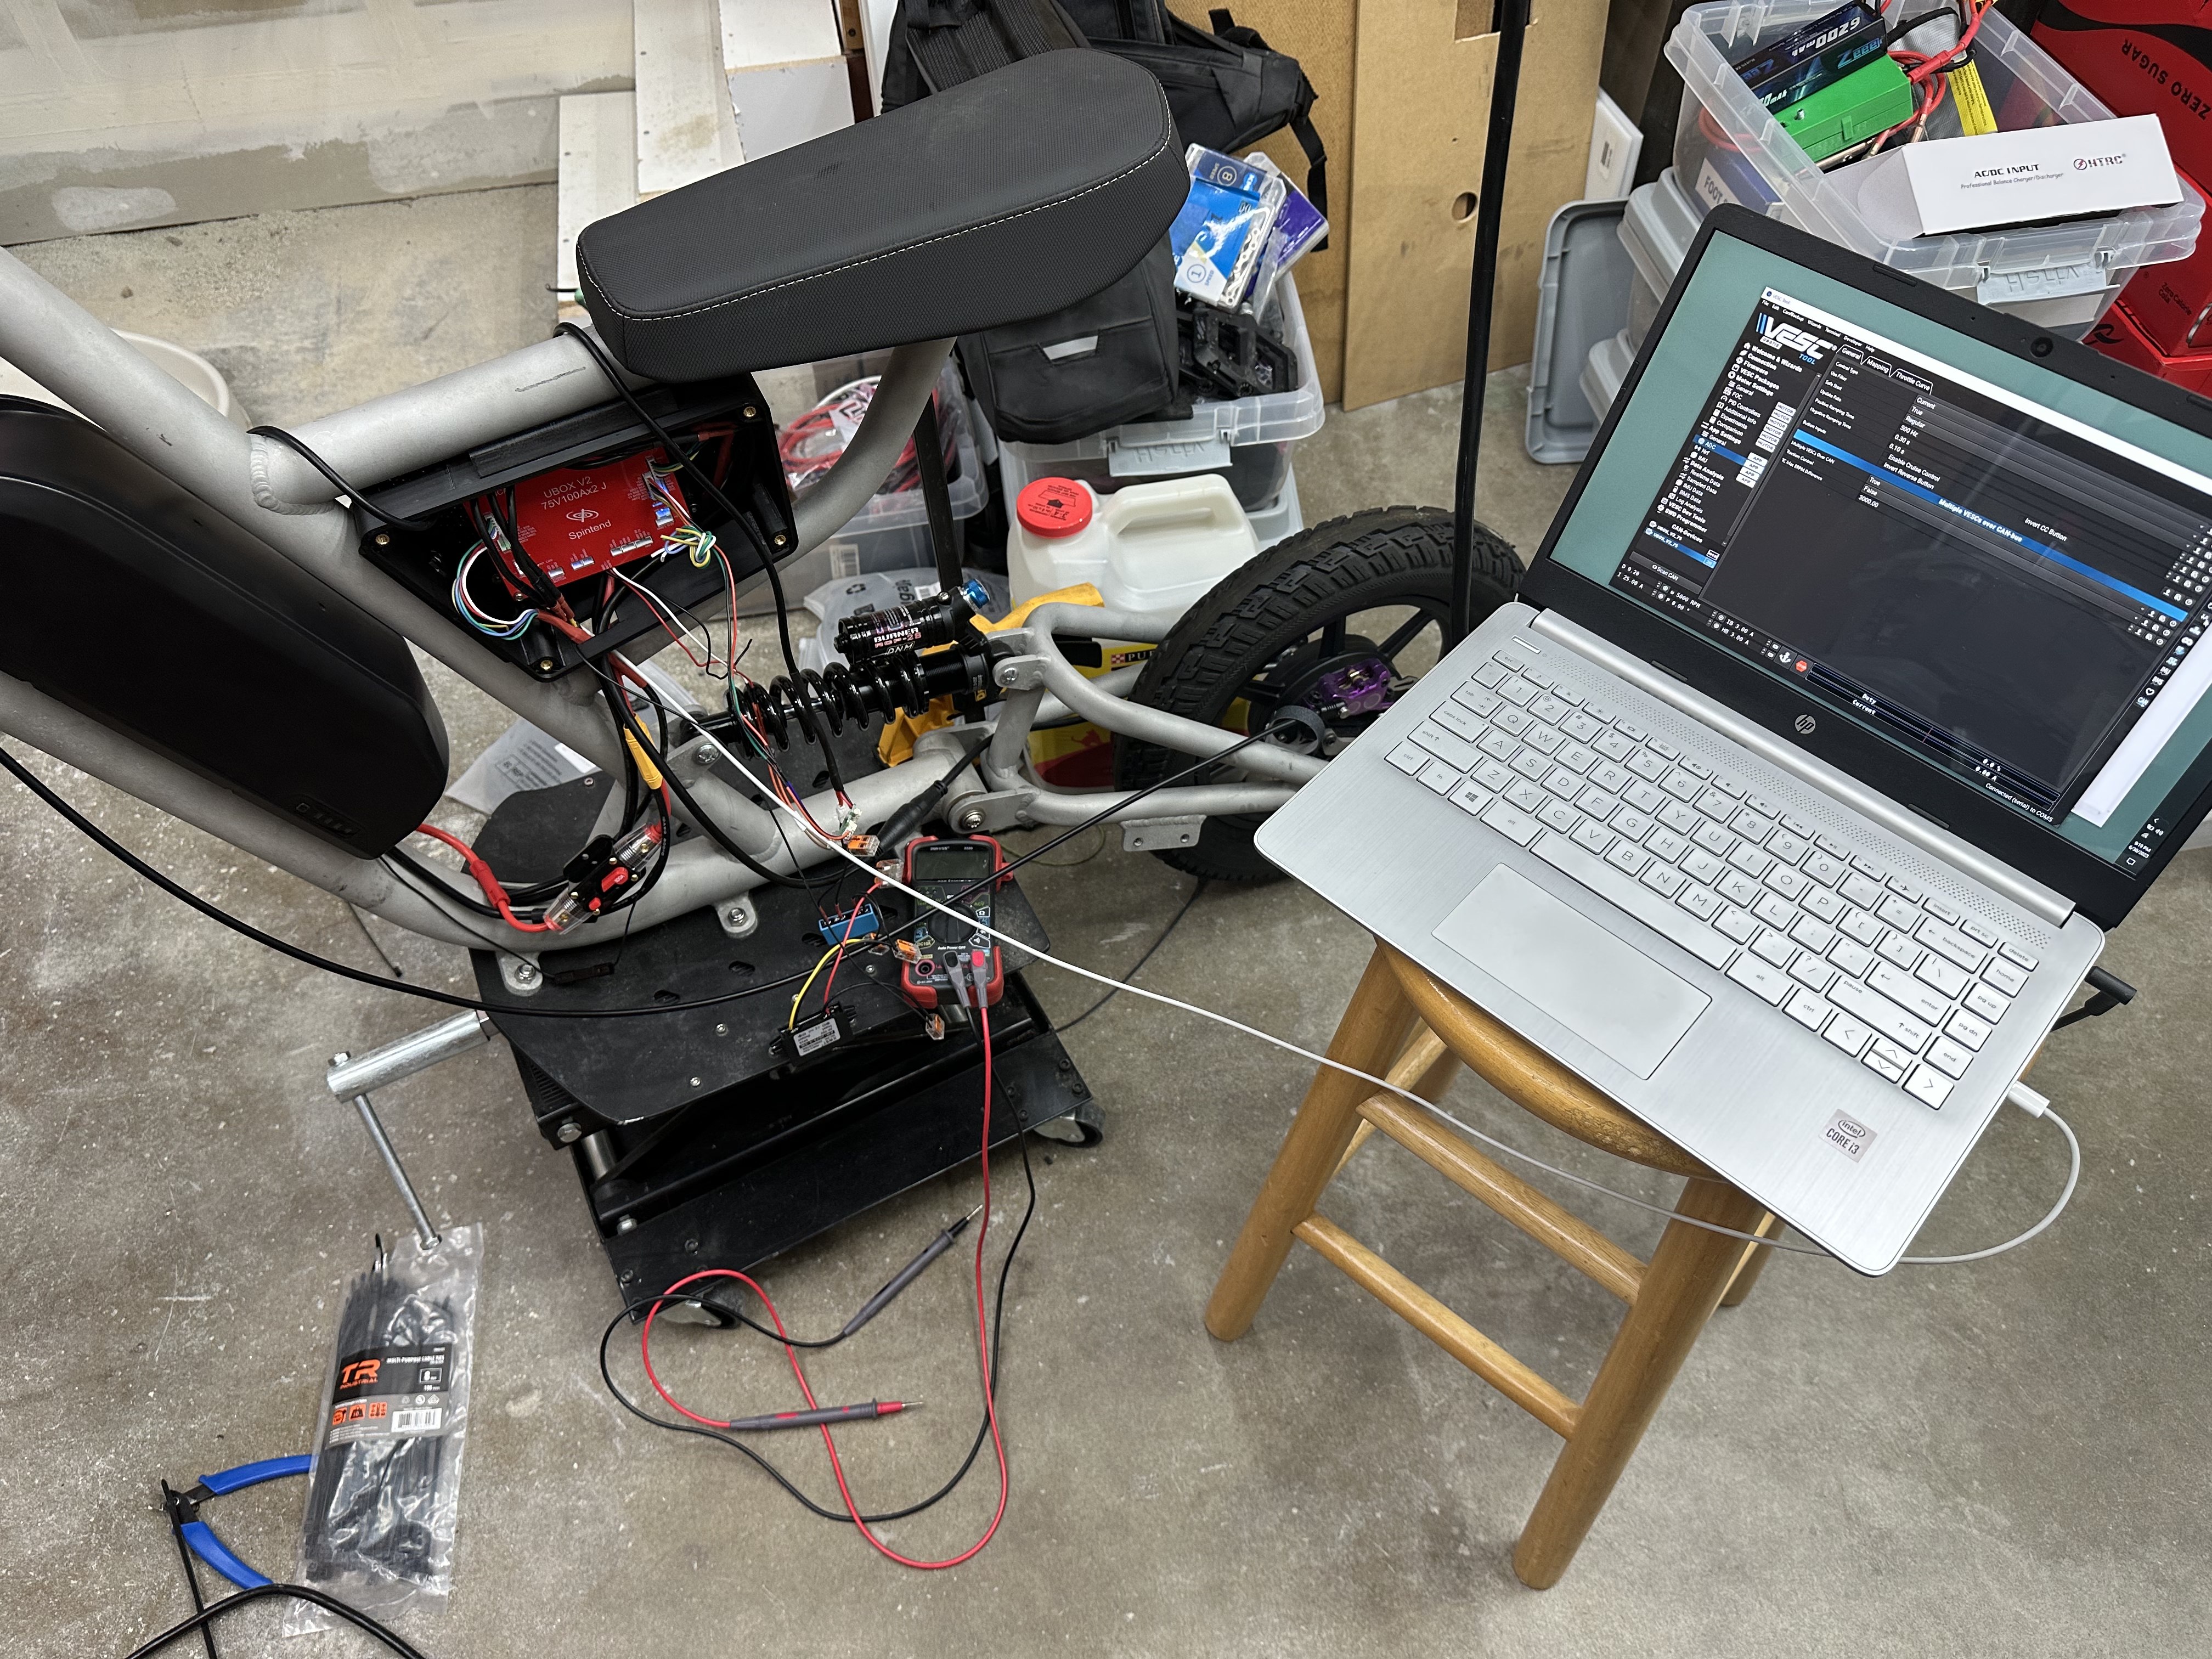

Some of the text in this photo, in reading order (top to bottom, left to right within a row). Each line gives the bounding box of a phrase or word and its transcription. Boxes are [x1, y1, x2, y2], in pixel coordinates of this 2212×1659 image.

[2121, 39, 2211, 121] ZERO SUGAR
[1222, 171, 1233, 181] 8
[1974, 164, 2039, 178] AC/DC INPUT
[1961, 180, 1992, 189] Professional
[2013, 173, 2064, 183] Charger/Discharger
[1704, 176, 1723, 204] FOOT
[2161, 281, 2174, 298] Zero
[1762, 337, 1780, 348] GRATIS
[1752, 345, 1775, 360] Welcome
[1781, 359, 1802, 373] Wizards
[1799, 354, 1816, 365] TOOL
[1842, 348, 1861, 360] General
[1743, 360, 1768, 375] Firmware
[1748, 353, 1776, 370] Connection
[1867, 358, 1889, 373] Mapping
[1736, 375, 1774, 396] Motor Settings
[1740, 368, 1780, 390] VESC Packages
[1896, 371, 1930, 391] Throttle Curve
[1736, 385, 1754, 396] General
[1736, 403, 1761, 417] Controllers
[1917, 397, 1936, 409] Current
[1724, 405, 1747, 420] Additional
[1717, 420, 1743, 436] Comparison
[1720, 413, 1748, 429] Experiments
[1905, 415, 1926, 428] Regular
[1709, 426, 1741, 444] App Settings
[1900, 425, 1911, 433] 500
[1705, 441, 1716, 450] ADC
[1709, 435, 1726, 446] General
[1690, 460, 1724, 480] Data Analysis
[1888, 454, 1940, 482] Enable Cruise Control
[1690, 469, 1720, 487] Realtime Data
[1869, 477, 1880, 486] True
[1883, 462, 1934, 490] Invert Reverse Button
[543, 476, 592, 498] UBOX V2
[1687, 476, 1717, 494] Sampled Data
[1863, 486, 1877, 495] False
[541, 481, 607, 510] 75V100Ax2 J
[1859, 494, 1878, 508] 3000.00
[1677, 514, 1707, 533] Programmer
[1938, 499, 2022, 542] Multiple VESCs over CAN-bus
[568, 519, 612, 540] Spintend
[1672, 524, 1702, 543] CAN-Devices
[2024, 518, 2067, 541] Invert CC Button
[1657, 567, 1679, 581] Scan CAN
[874, 627, 918, 642] BURNER
[1508, 715, 1518, 724] Q
[1796, 714, 1815, 733] hp
[1539, 731, 1553, 742] W
[1571, 752, 1582, 761] E
[1487, 770, 1500, 780] Z
[1558, 777, 1569, 786] D
[1604, 770, 1615, 780] R
[1519, 789, 1532, 799] X
[1985, 783, 2012, 800] Connected
[2011, 797, 2030, 810] (serial)
[2036, 810, 2053, 822] COM5
[1554, 811, 1565, 819] C
[1676, 810, 1686, 819] Y
[1627, 819, 1638, 827] G
[1590, 830, 1600, 838] V
[1709, 832, 1720, 841] U
[1661, 838, 1673, 849] H
[1622, 851, 1633, 861] B
[1657, 872, 1670, 883] N
[1781, 876, 1792, 884] O
[1732, 882, 1745, 893] K
[1693, 894, 1707, 906] M
[1770, 905, 1777, 916] L
[1933, 903, 1951, 916] insert
[1943, 938, 1974, 958] backspace
[2008, 947, 2029, 962] delete
[1996, 969, 2014, 982] home
[1844, 981, 1863, 993] pause
[1921, 1000, 1938, 1010] enter
[1905, 1028, 1918, 1038] shift
[1968, 1028, 1978, 1036] dn
[1944, 1053, 1956, 1062] end
[1842, 1120, 1861, 1136] intel
[1826, 1128, 1859, 1154] CORE i3
[342, 1359, 381, 1384] TR
